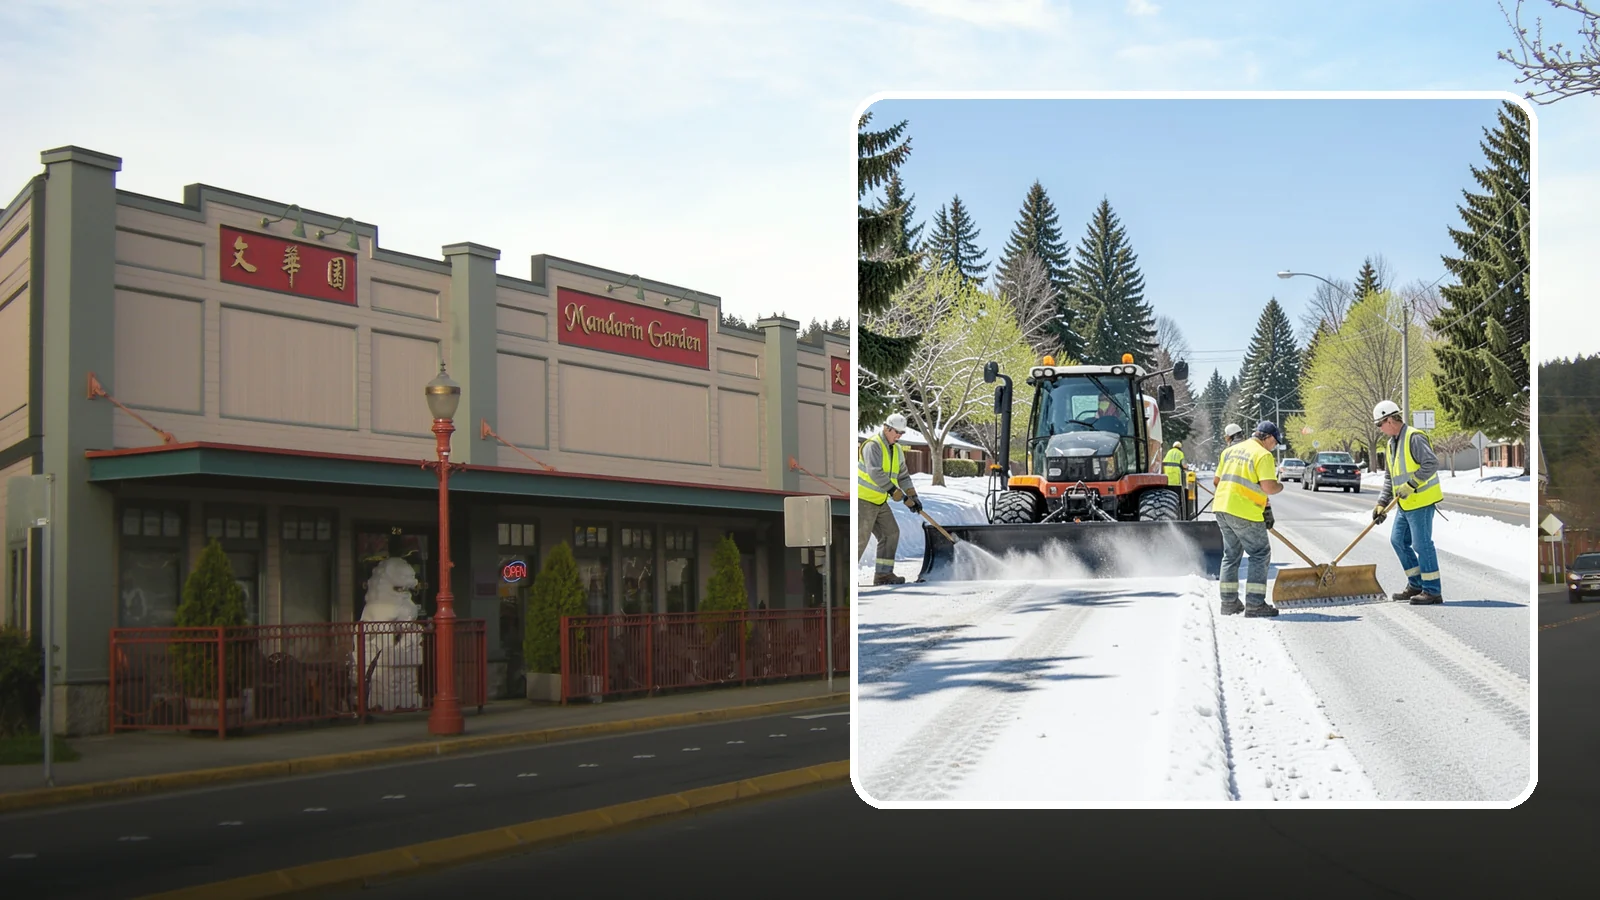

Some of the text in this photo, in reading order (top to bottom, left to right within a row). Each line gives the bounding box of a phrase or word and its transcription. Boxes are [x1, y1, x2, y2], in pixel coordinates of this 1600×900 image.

[231, 235, 347, 290] 文華園
[564, 302, 702, 352] Mandarin Garden
[503, 565, 527, 578] OPEN
